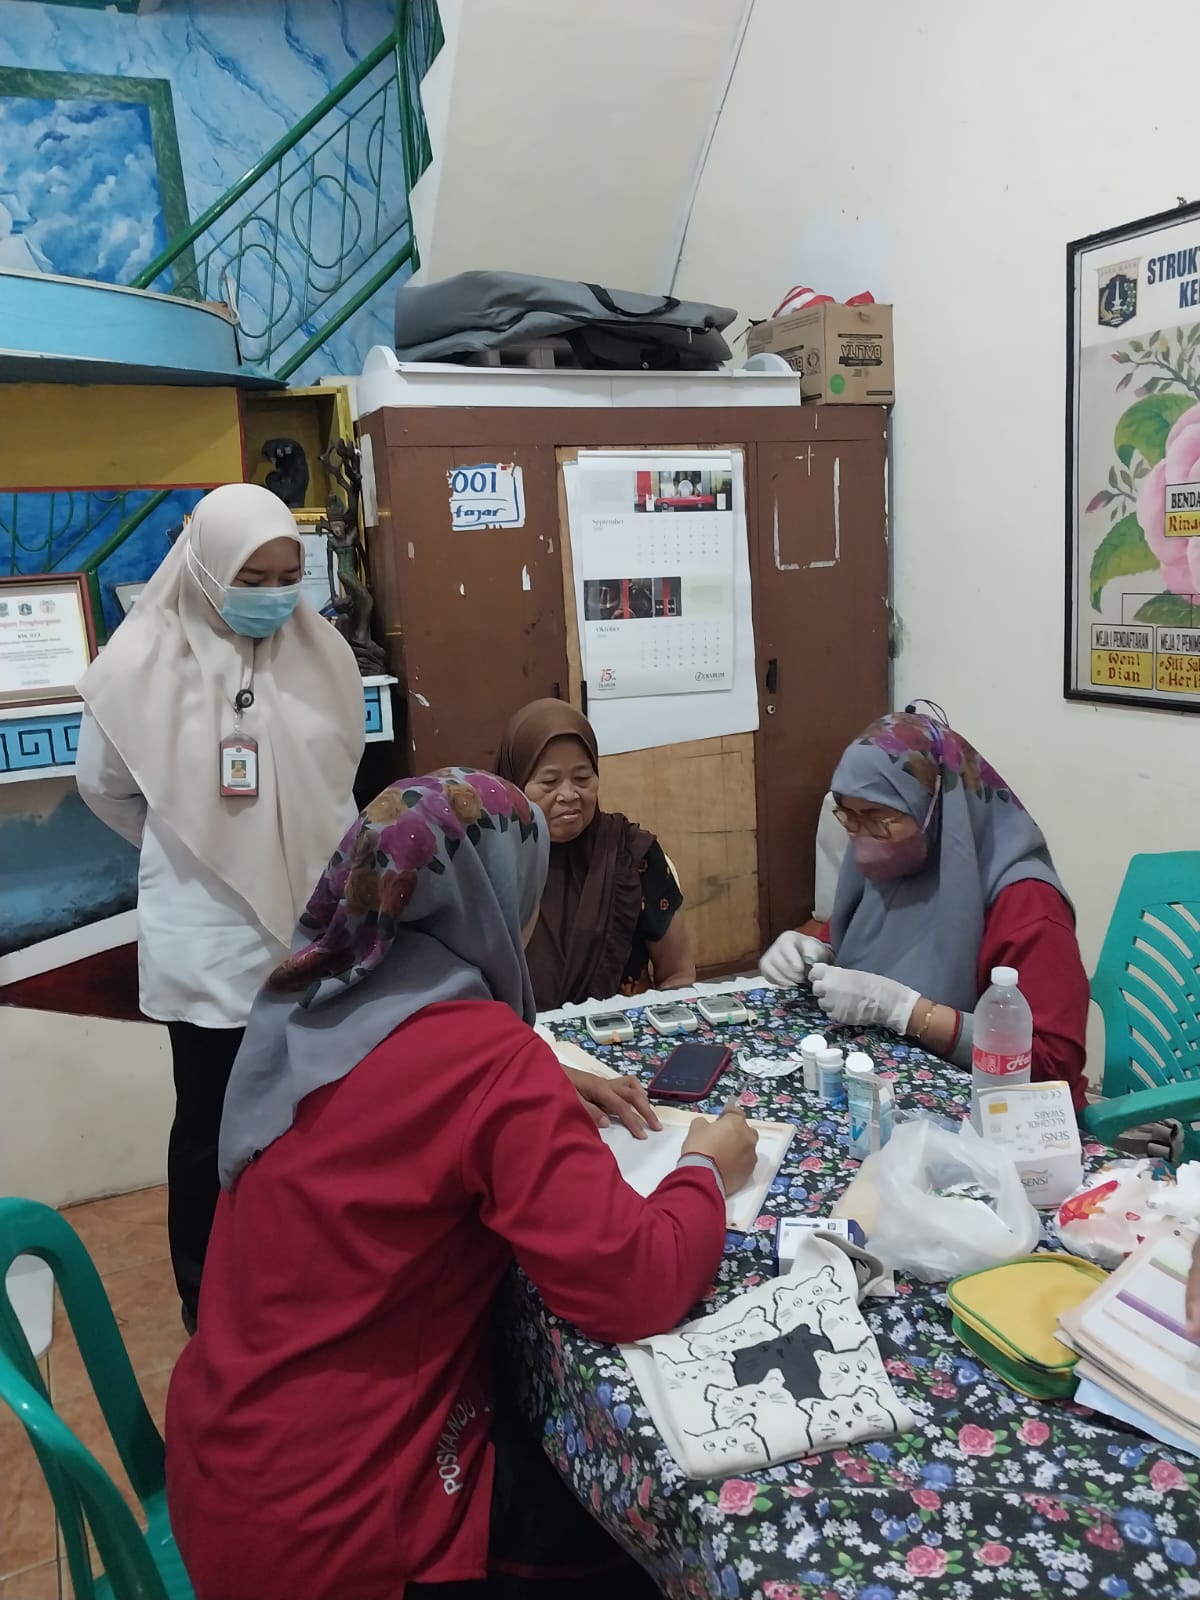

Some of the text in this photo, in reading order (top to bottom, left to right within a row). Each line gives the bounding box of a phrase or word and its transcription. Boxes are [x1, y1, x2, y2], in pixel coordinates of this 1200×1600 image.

[1179, 279, 1200, 308] KE
[841, 344, 882, 359] BALITA
[452, 471, 496, 493] 001
[1169, 515, 1200, 532] Rina
[1108, 667, 1141, 683] Dian
[1027, 1118, 1066, 1129] ALCOHOL
[1041, 1130, 1070, 1142] SENSI
[1021, 1176, 1049, 1186] SENSI
